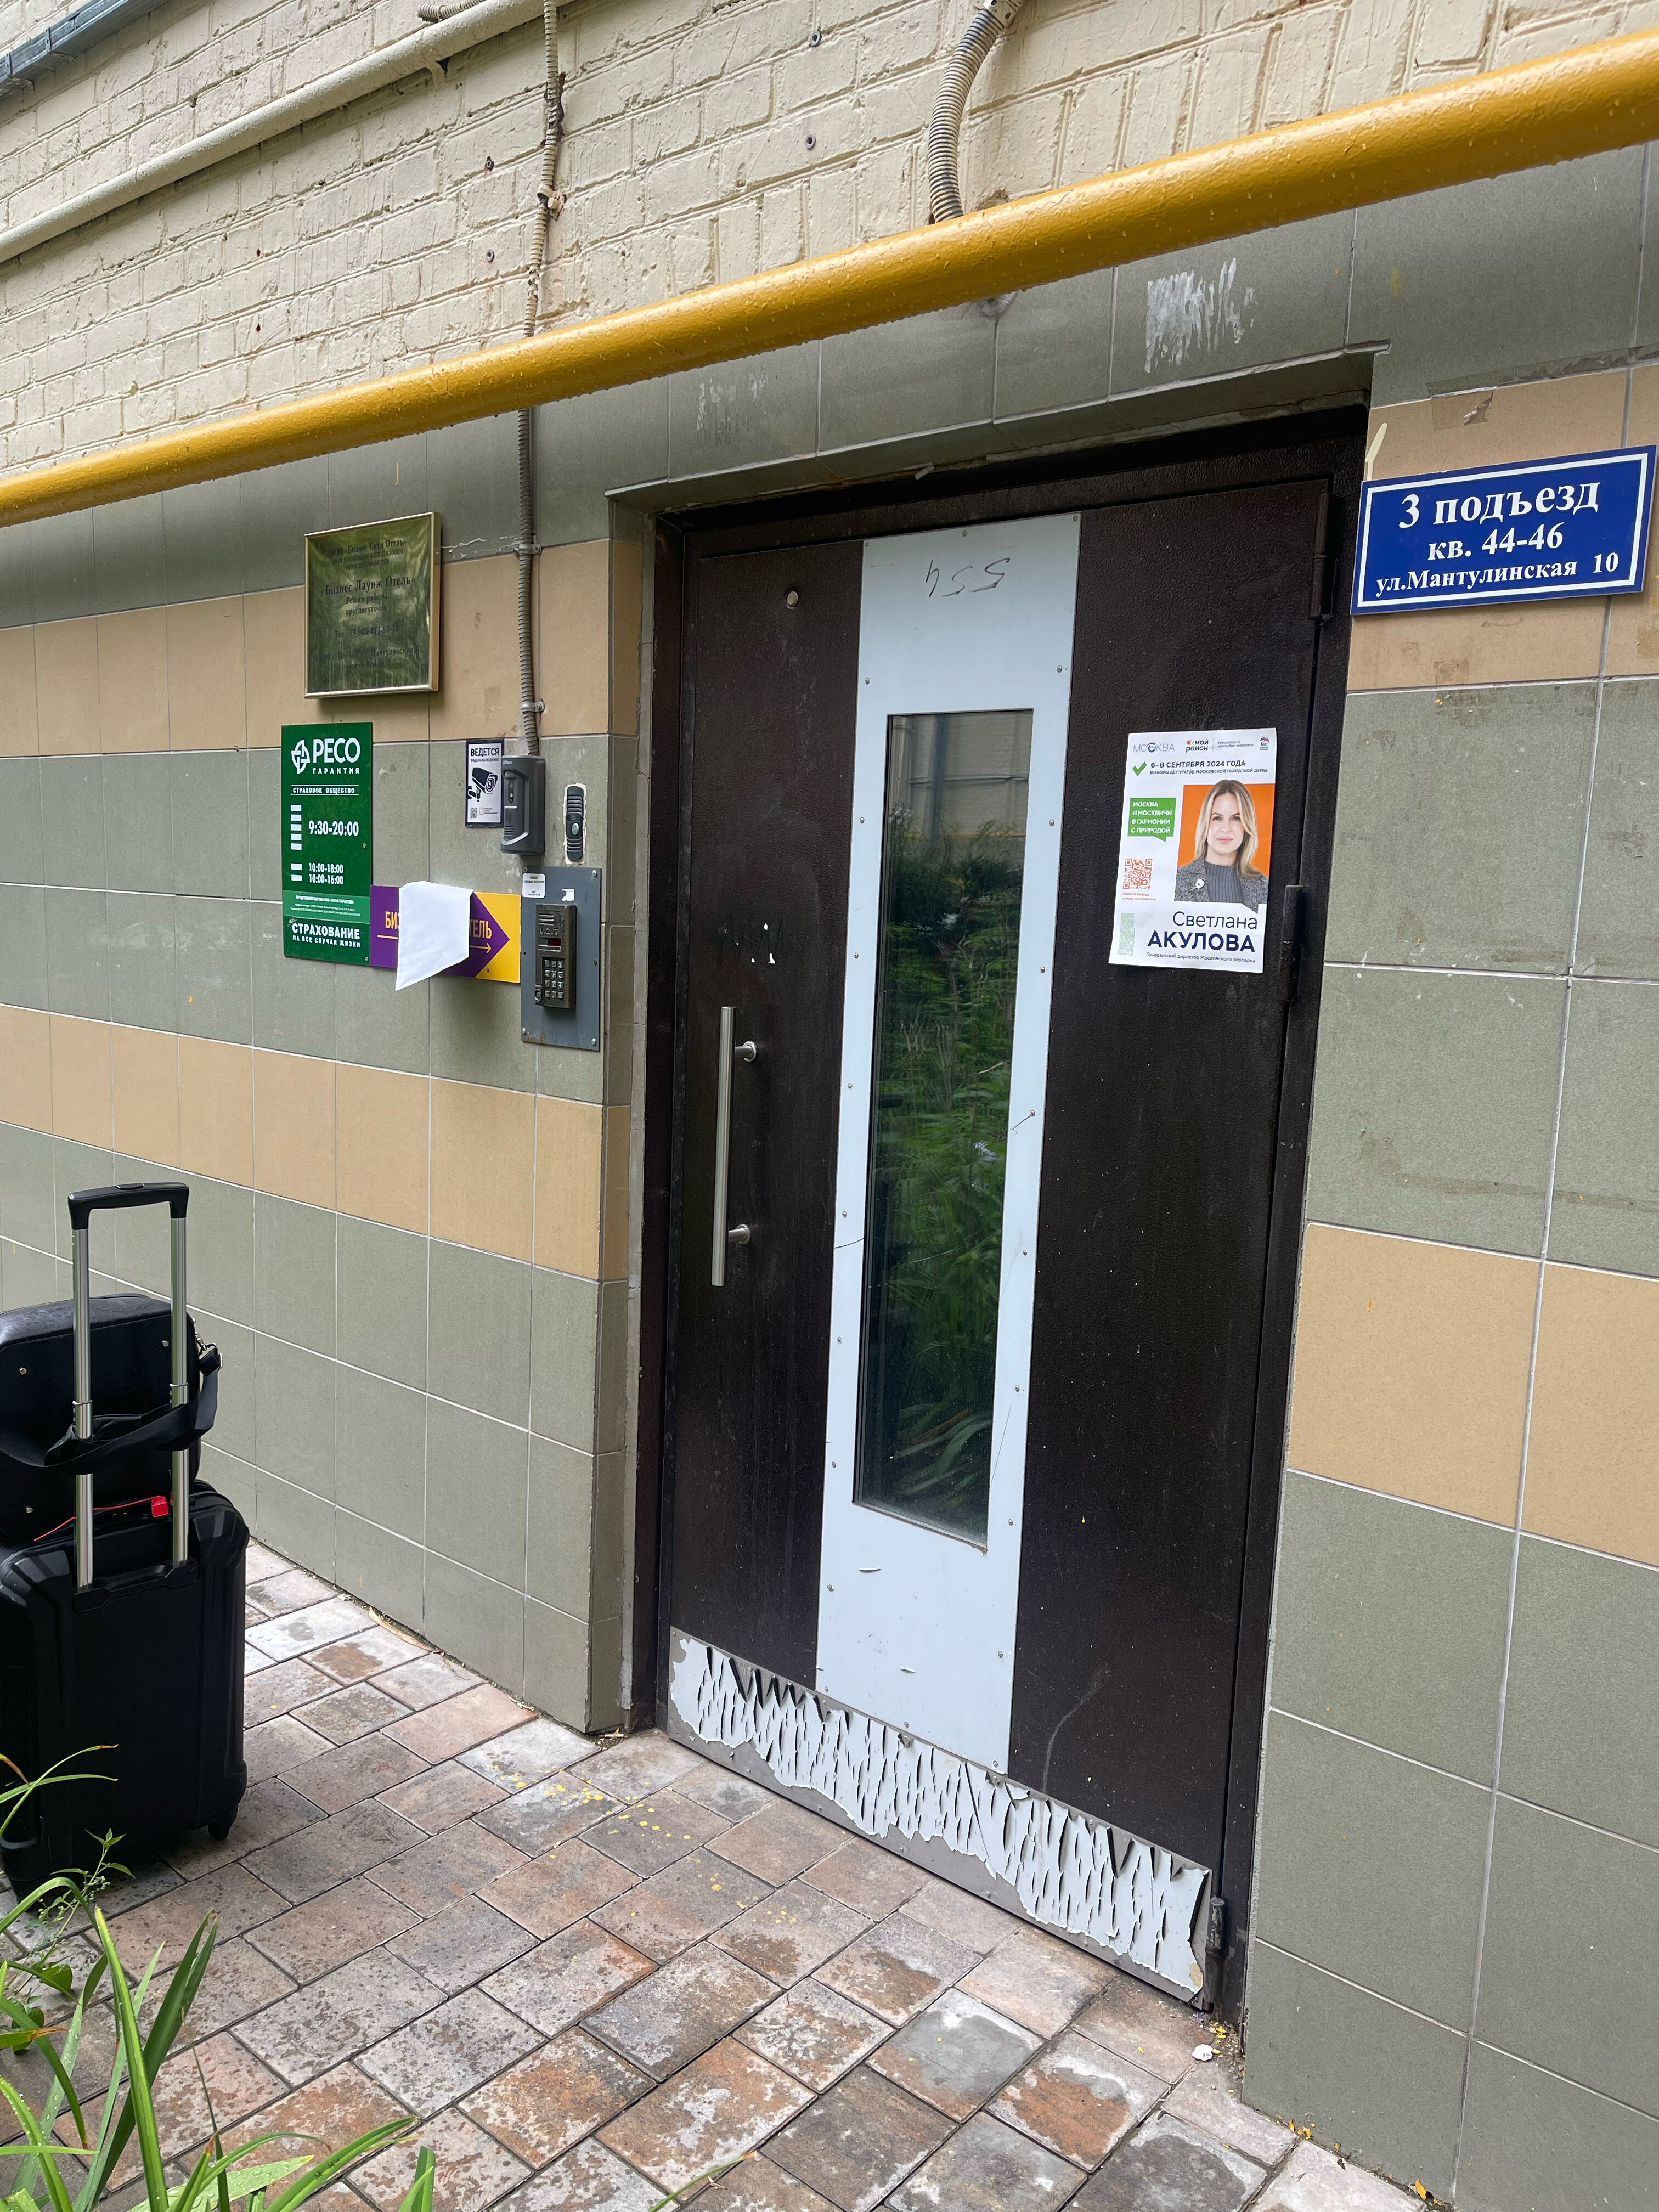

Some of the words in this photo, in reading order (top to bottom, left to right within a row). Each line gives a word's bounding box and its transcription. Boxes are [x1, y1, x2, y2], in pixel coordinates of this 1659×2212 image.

[1398, 493, 1420, 529] 3
[1432, 481, 1601, 525] подъезд
[1427, 539, 1472, 561] кв.
[1481, 522, 1565, 555] 44-46
[1375, 560, 1578, 598] ул.Мантулинская
[1592, 552, 1619, 575] 10
[325, 584, 352, 596] Бизнес
[355, 579, 382, 593] Лаунж
[346, 606, 387, 617] круглосуточно
[313, 737, 360, 763] РЕСО
[470, 748, 499, 757] ВЕДЕТСЯ
[1133, 742, 1175, 753] МОСКВА
[308, 820, 359, 837] 9:30-20:00
[308, 862, 344, 874] 10:00-18:00
[308, 873, 344, 885] 10:00-16:00
[1173, 911, 1257, 929] Светлана
[292, 922, 360, 940] СТРАХОВАНИЕ
[339, 940, 360, 948] ЖИЗНИ
[1147, 930, 1256, 953] АКУЛОВА
